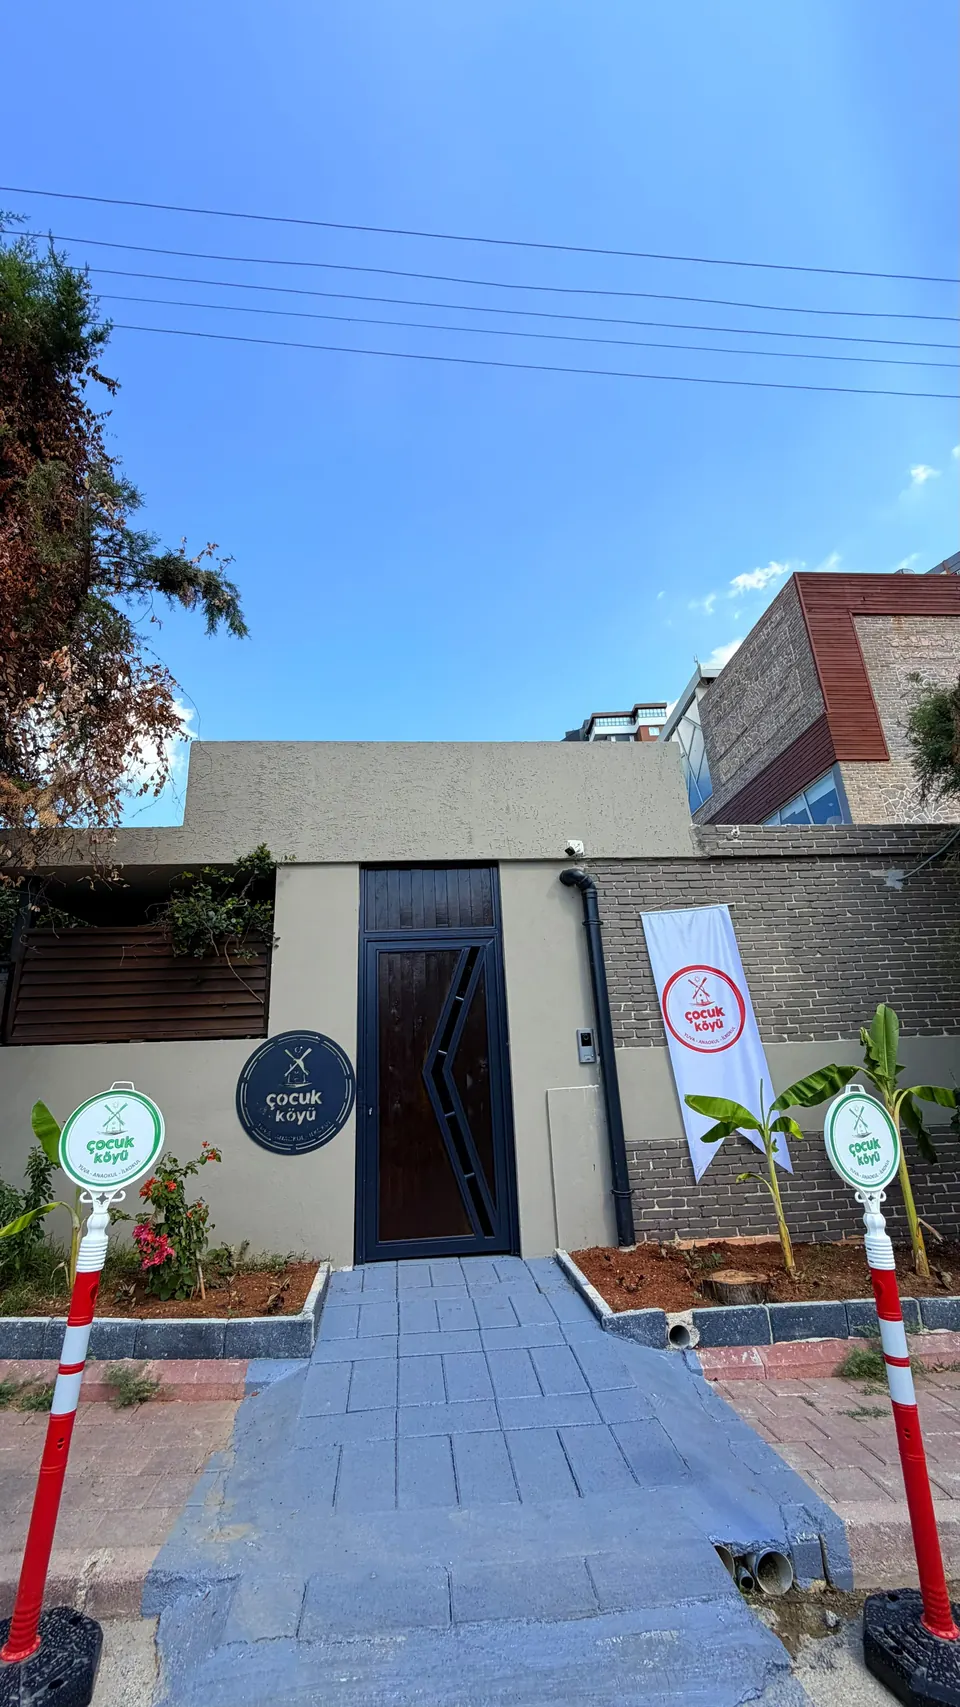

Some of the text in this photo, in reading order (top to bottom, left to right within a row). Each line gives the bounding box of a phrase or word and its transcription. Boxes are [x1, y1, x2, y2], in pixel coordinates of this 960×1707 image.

[684, 1006, 726, 1024] çocuk
[694, 1019, 724, 1032] köyü
[266, 1090, 322, 1110] çocuk
[276, 1108, 316, 1125] köyü
[86, 1136, 134, 1154] çocuk
[848, 1138, 881, 1157] çocuk
[94, 1150, 128, 1165] köyü
[857, 1151, 880, 1166] köyü
